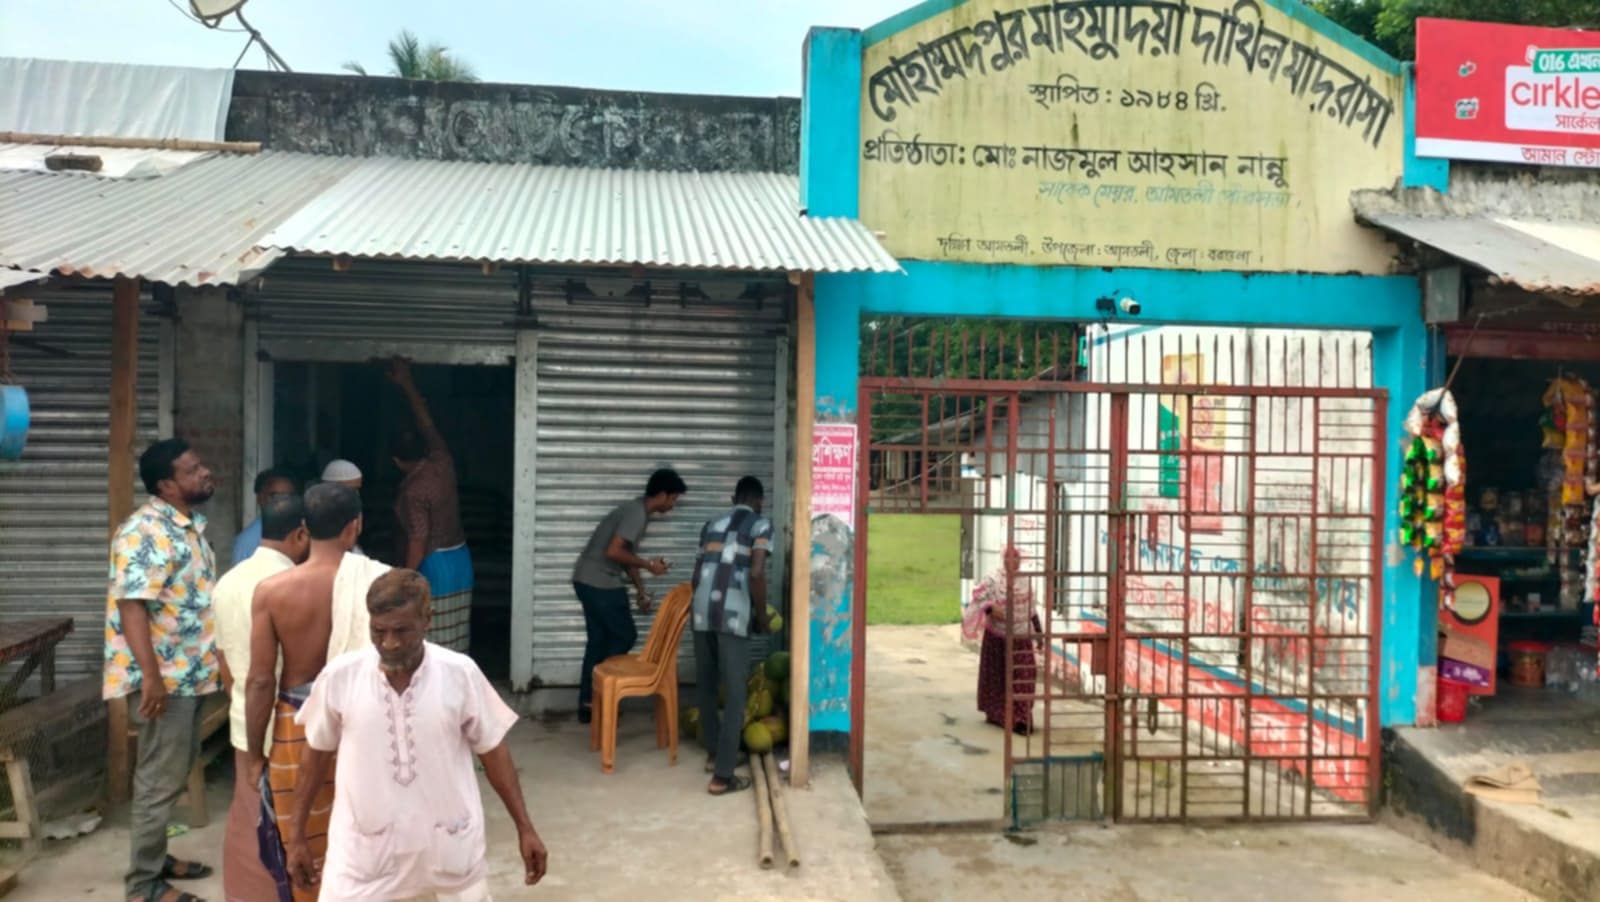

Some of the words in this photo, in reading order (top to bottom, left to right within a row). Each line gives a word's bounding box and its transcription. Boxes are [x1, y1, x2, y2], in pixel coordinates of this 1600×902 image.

[1191, 0, 1290, 84] দাখিল
[1539, 53, 1565, 71] 016
[1120, 88, 1188, 111] ১৯৮৪
[1128, 149, 1229, 180] আহসান
[1520, 146, 1567, 165] আমান
[1573, 149, 1600, 166] স্টো
